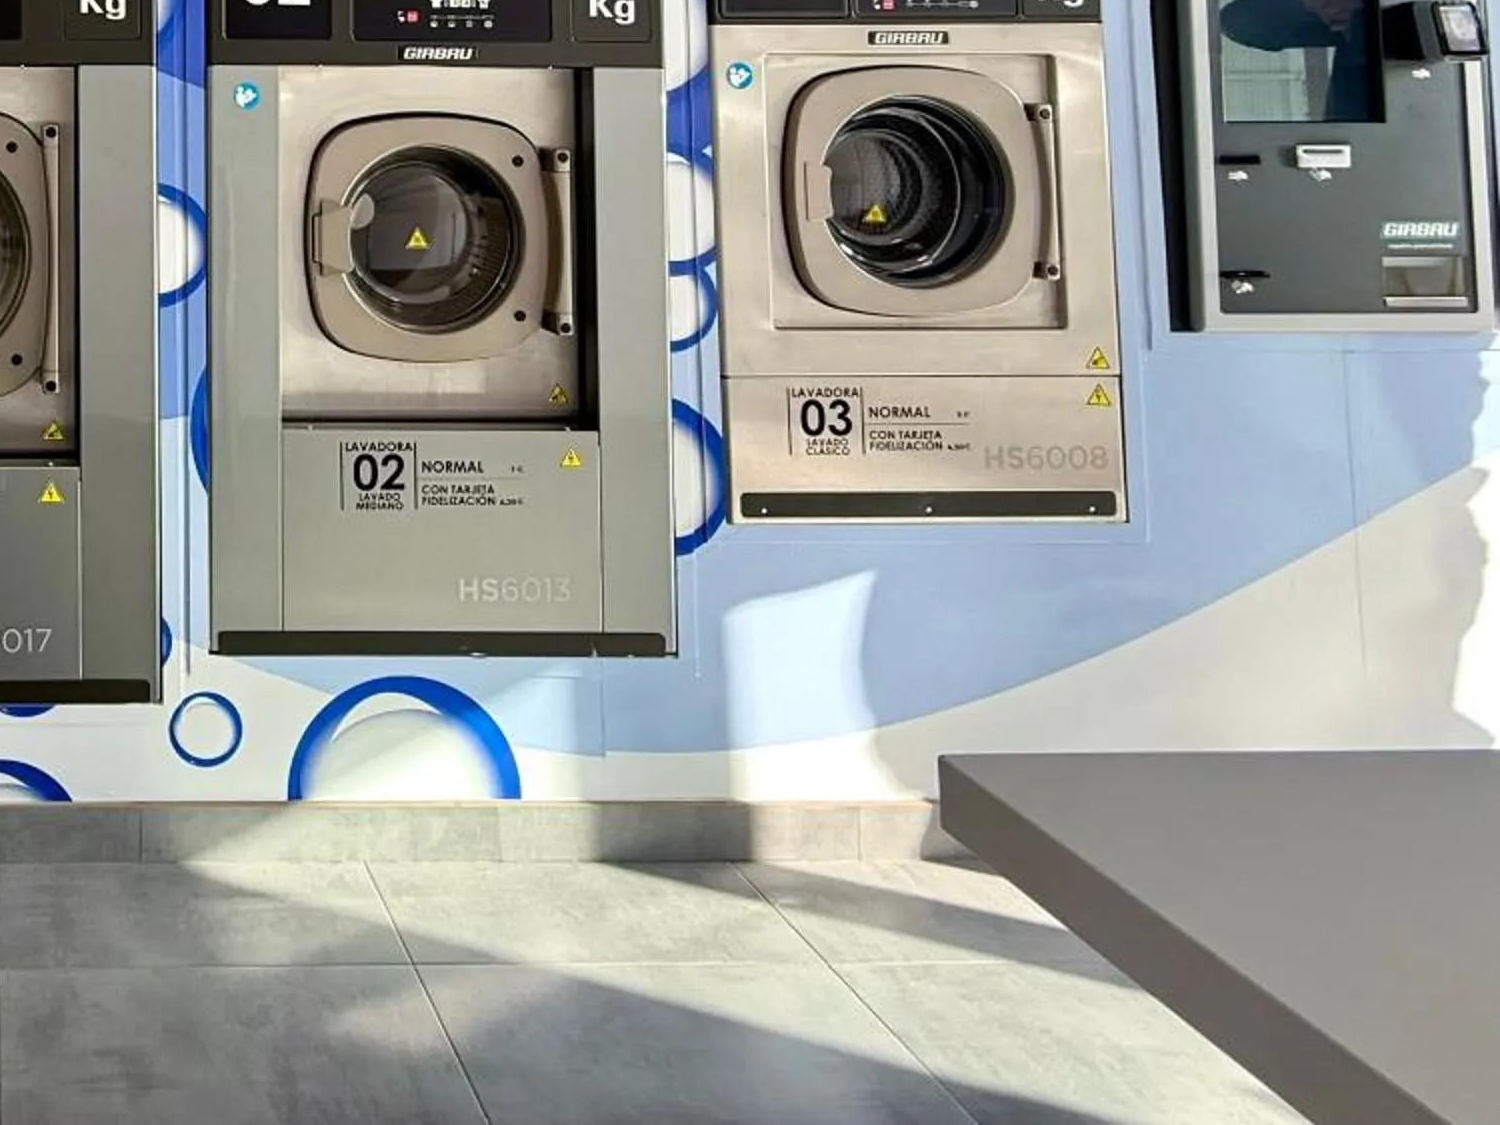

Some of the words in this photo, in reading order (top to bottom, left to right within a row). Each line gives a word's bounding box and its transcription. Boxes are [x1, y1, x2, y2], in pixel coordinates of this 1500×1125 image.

[875, 33, 944, 44] GIRBAU
[404, 48, 472, 60] GIRBAU
[1383, 222, 1459, 236] GIRBAU
[791, 388, 859, 397] LAVADORA
[801, 399, 852, 436] 03
[869, 407, 931, 418] NORMAL
[869, 431, 895, 440] CON
[899, 431, 942, 439] TARJETA
[345, 442, 413, 452] LAVADORA
[983, 445, 1109, 469] HS6008
[353, 454, 405, 491] 02
[421, 461, 484, 473] NORMAL
[421, 485, 448, 494] CON
[451, 485, 495, 494] TARJETA
[359, 493, 401, 501] LAVADO
[356, 502, 404, 510] MEDIANO
[459, 578, 572, 602] HS6013
